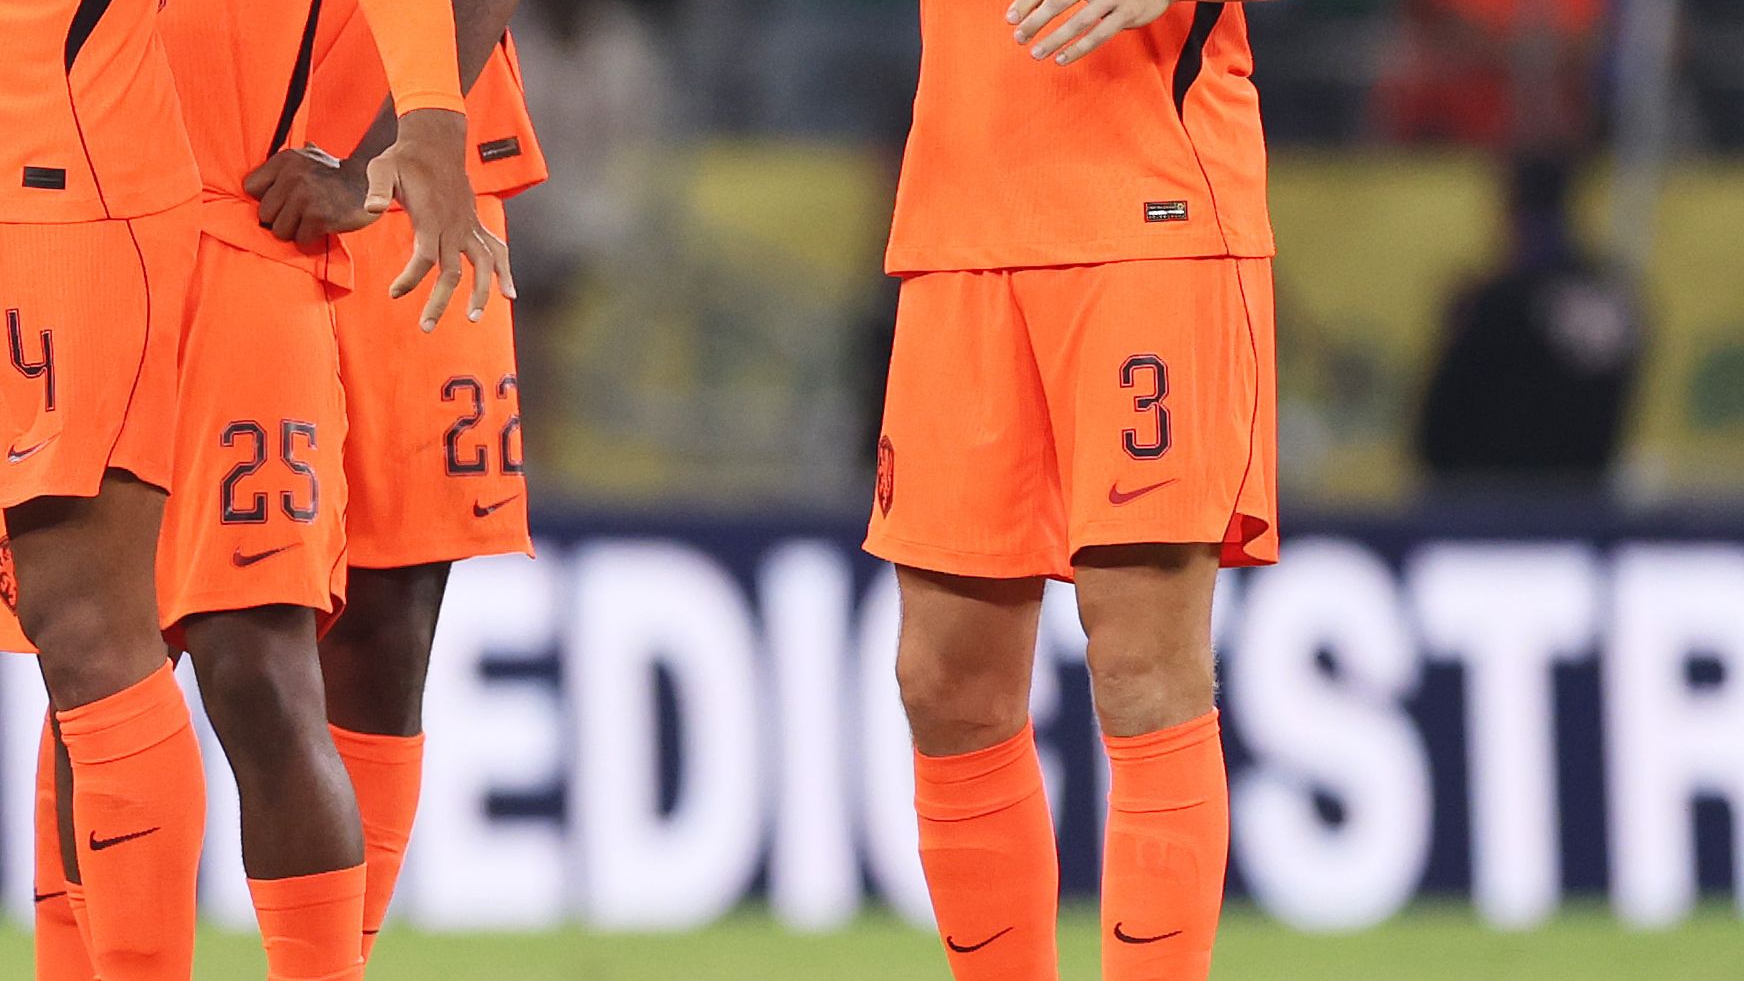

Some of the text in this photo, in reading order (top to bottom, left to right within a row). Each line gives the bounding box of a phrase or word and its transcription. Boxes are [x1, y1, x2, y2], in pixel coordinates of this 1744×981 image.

[5, 307, 55, 412] 4
[1119, 354, 1170, 460] 3
[220, 420, 319, 525] 25
